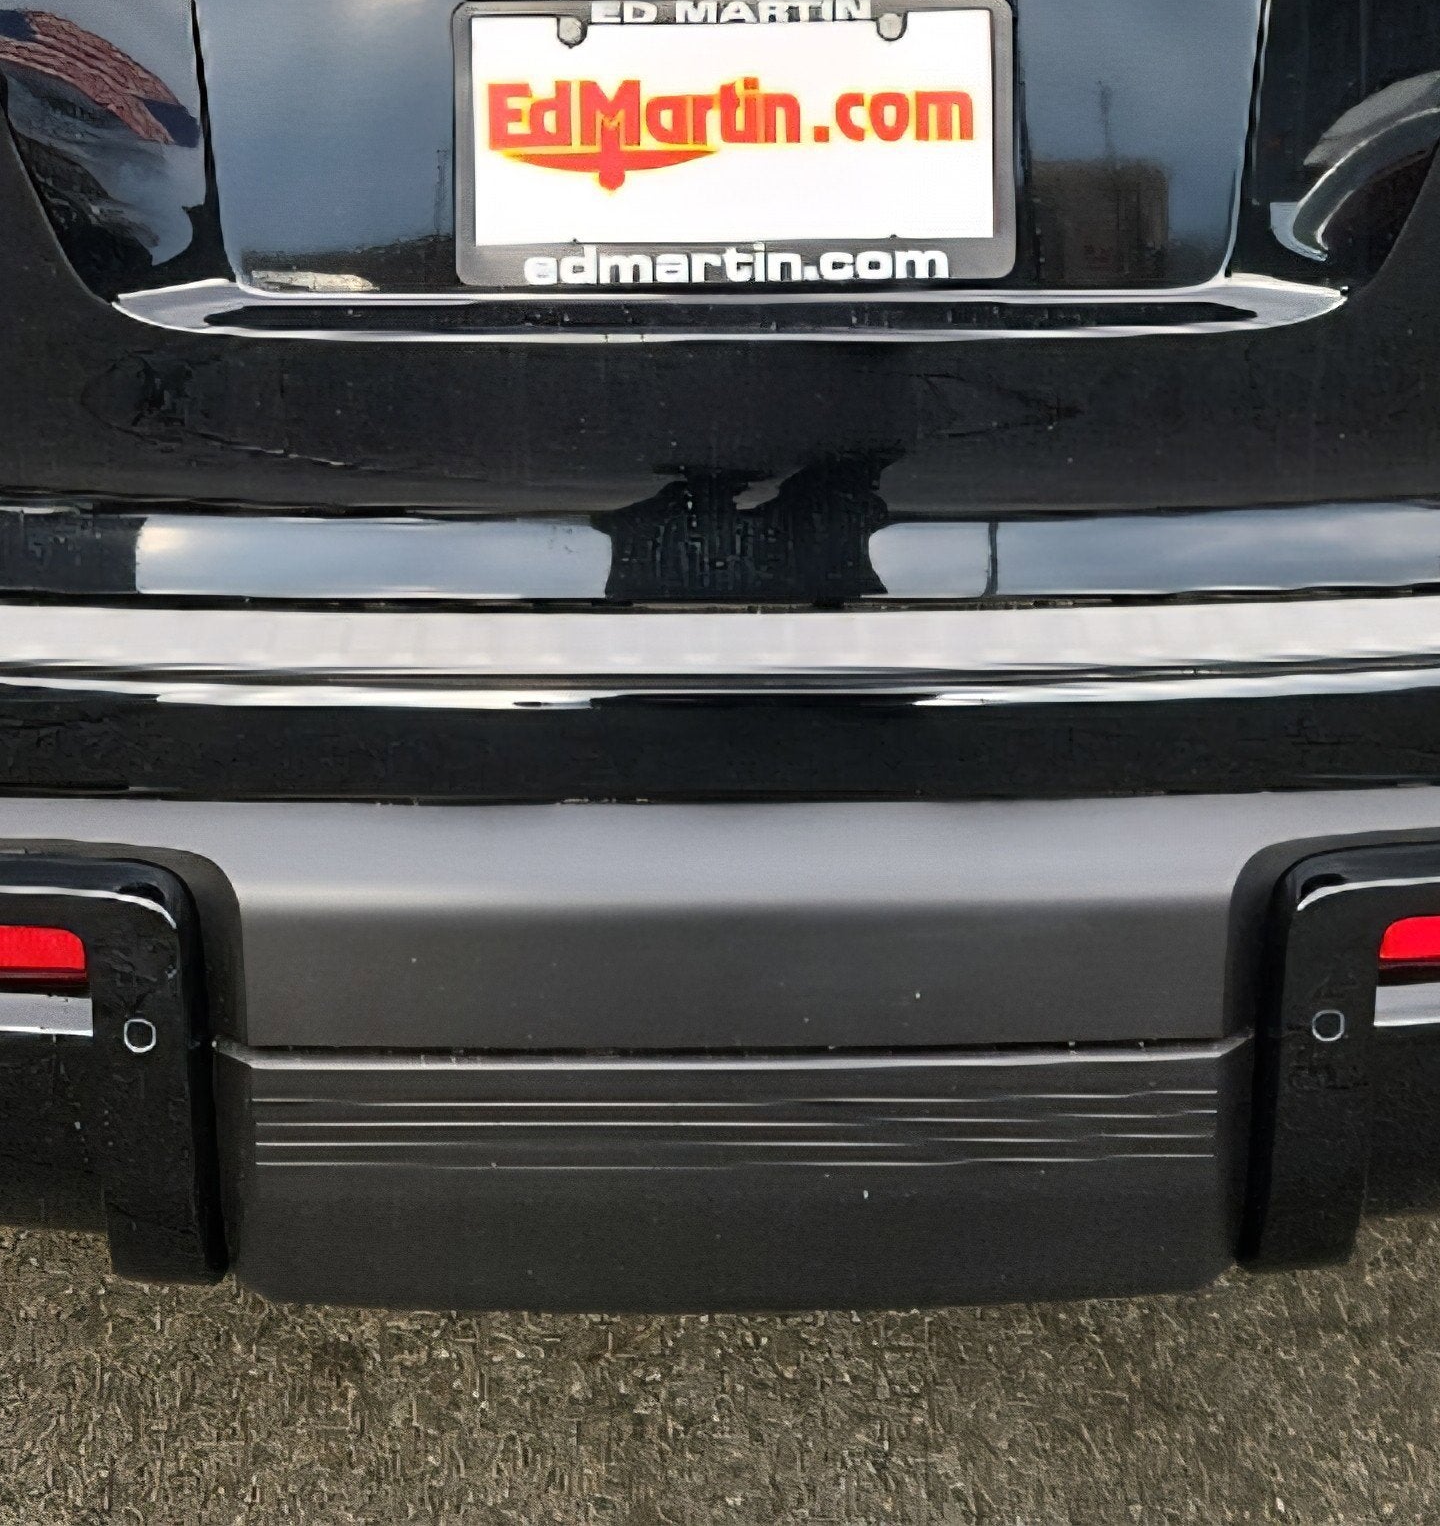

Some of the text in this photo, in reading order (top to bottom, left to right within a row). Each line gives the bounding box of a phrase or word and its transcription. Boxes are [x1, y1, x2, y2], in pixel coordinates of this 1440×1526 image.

[591, 0, 658, 25] ED
[487, 76, 975, 152] EdMartin.com
[523, 242, 949, 286] edmartin.com
